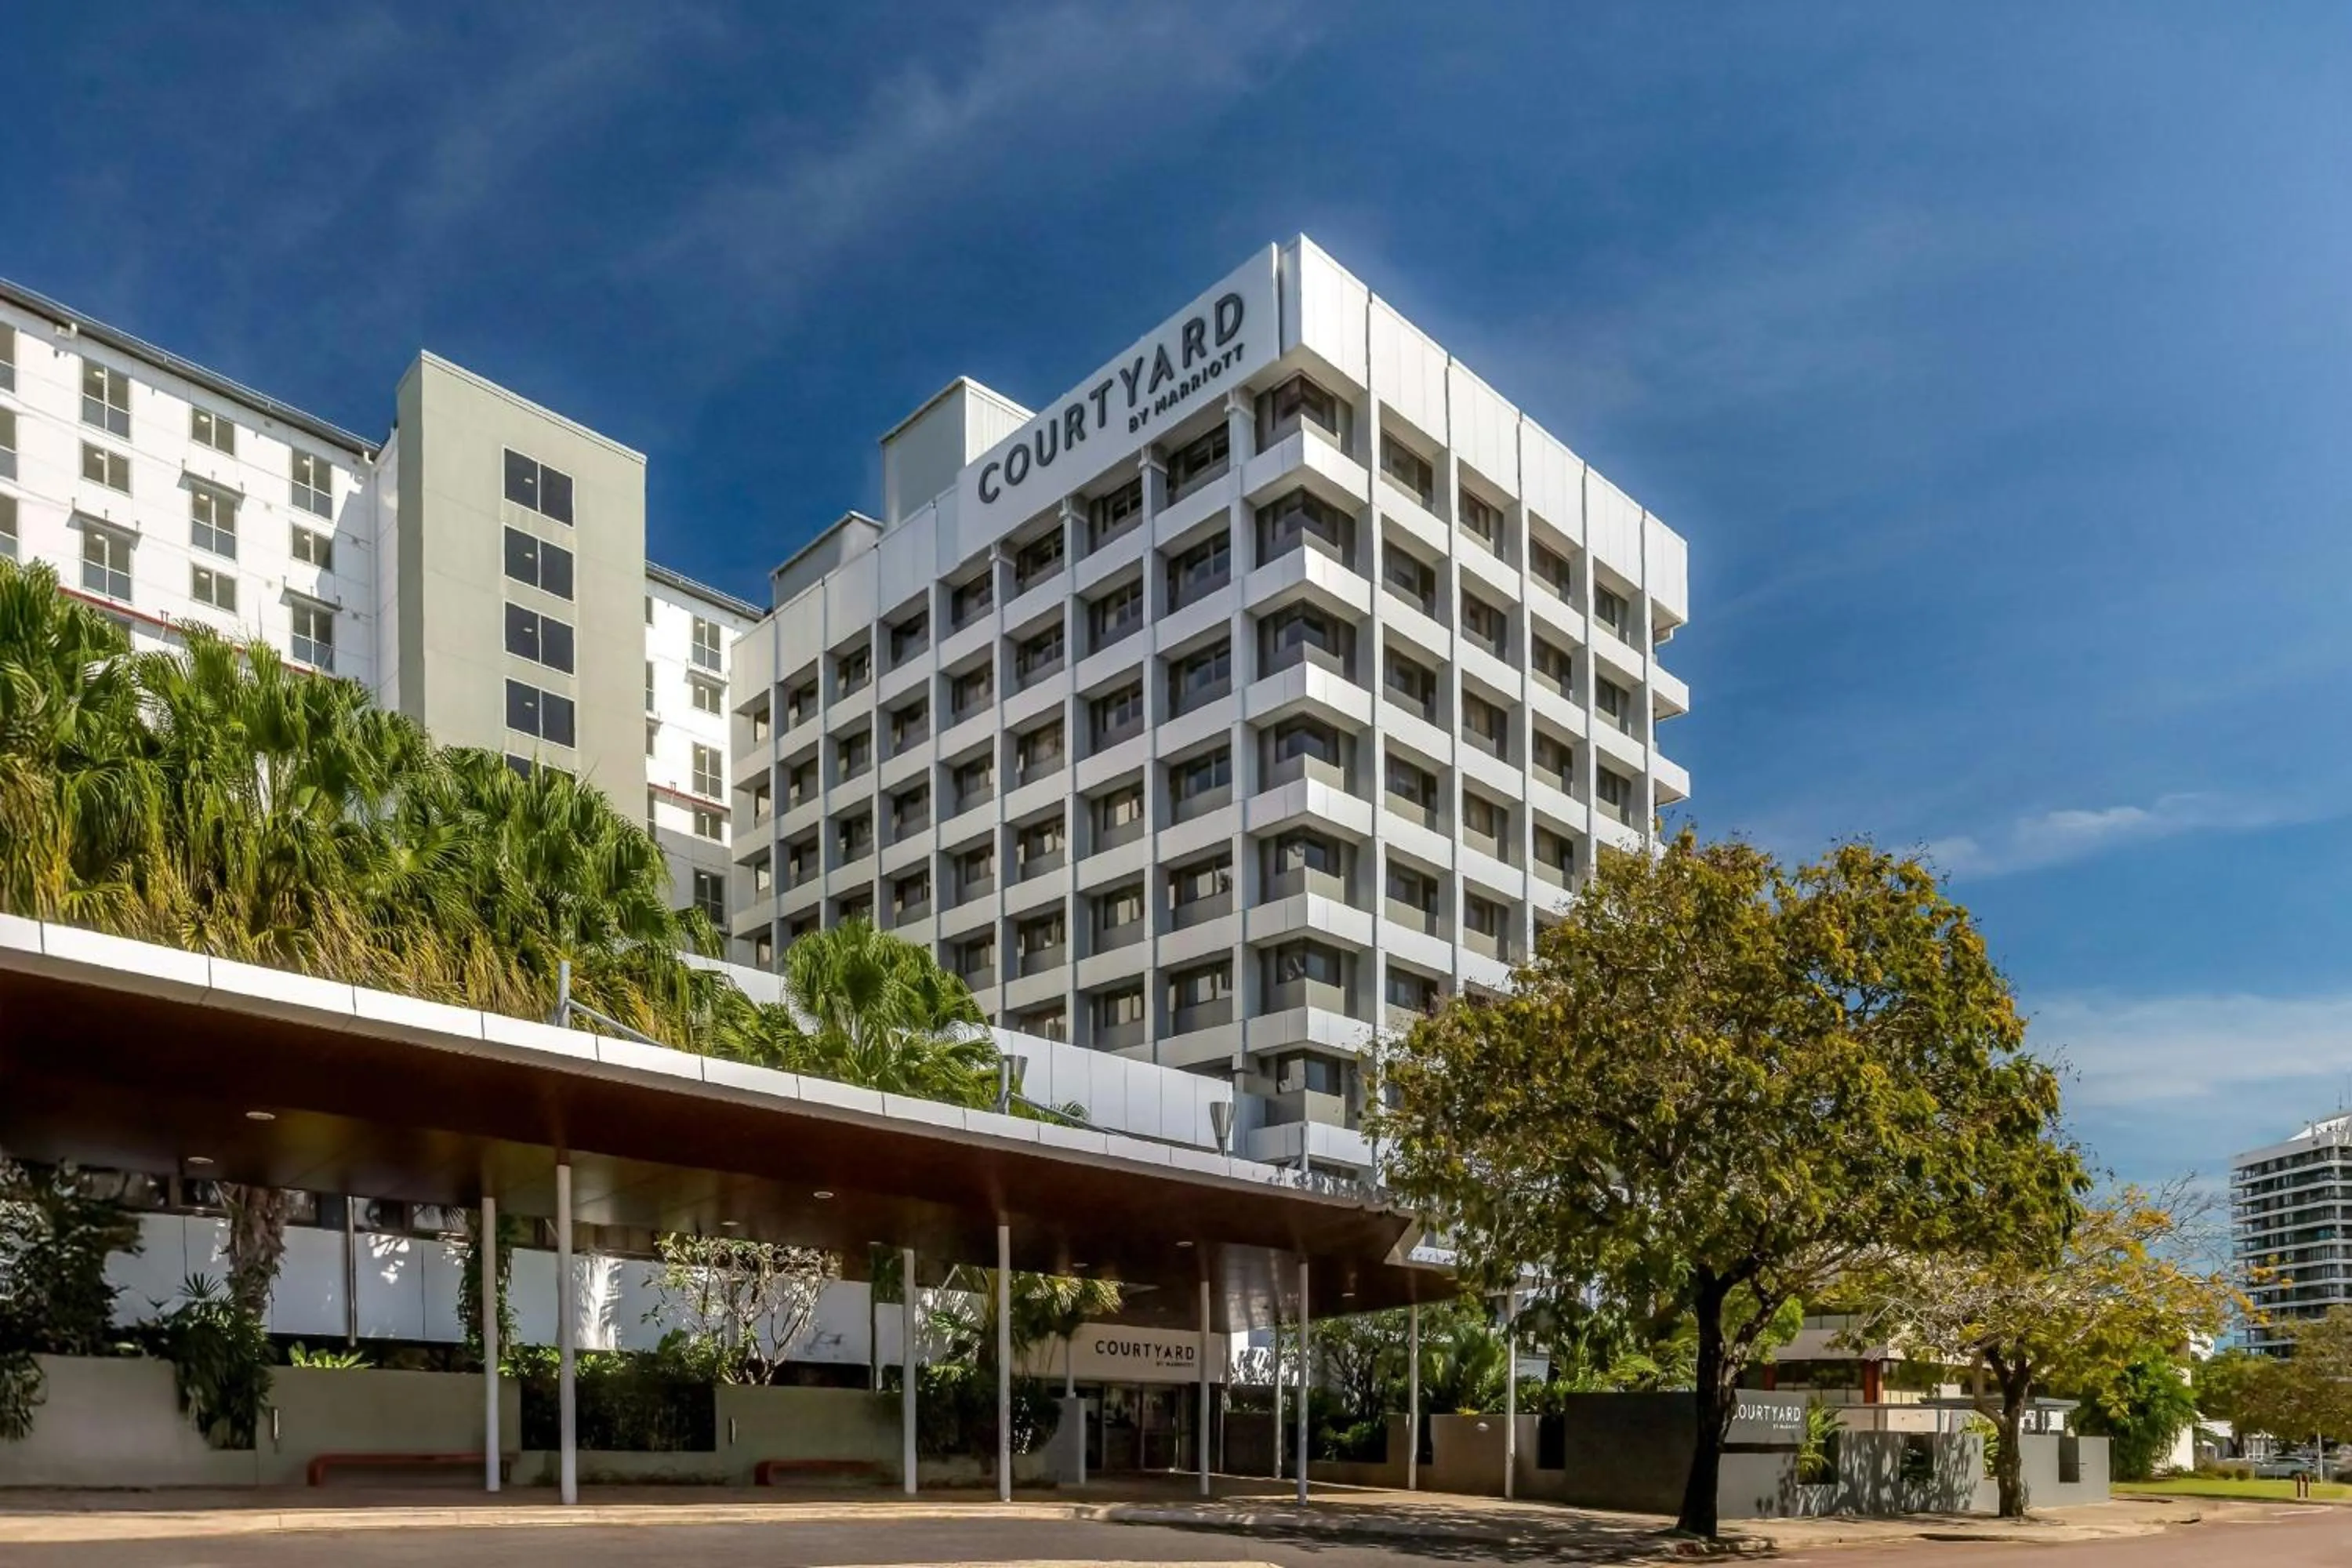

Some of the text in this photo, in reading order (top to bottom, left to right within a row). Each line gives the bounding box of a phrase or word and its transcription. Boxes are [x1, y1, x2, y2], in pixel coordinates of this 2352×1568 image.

[978, 292, 1245, 504] COURTYARD
[1128, 342, 1245, 434] BY MARRIOTT
[1094, 1340, 1195, 1361] COURTYARD
